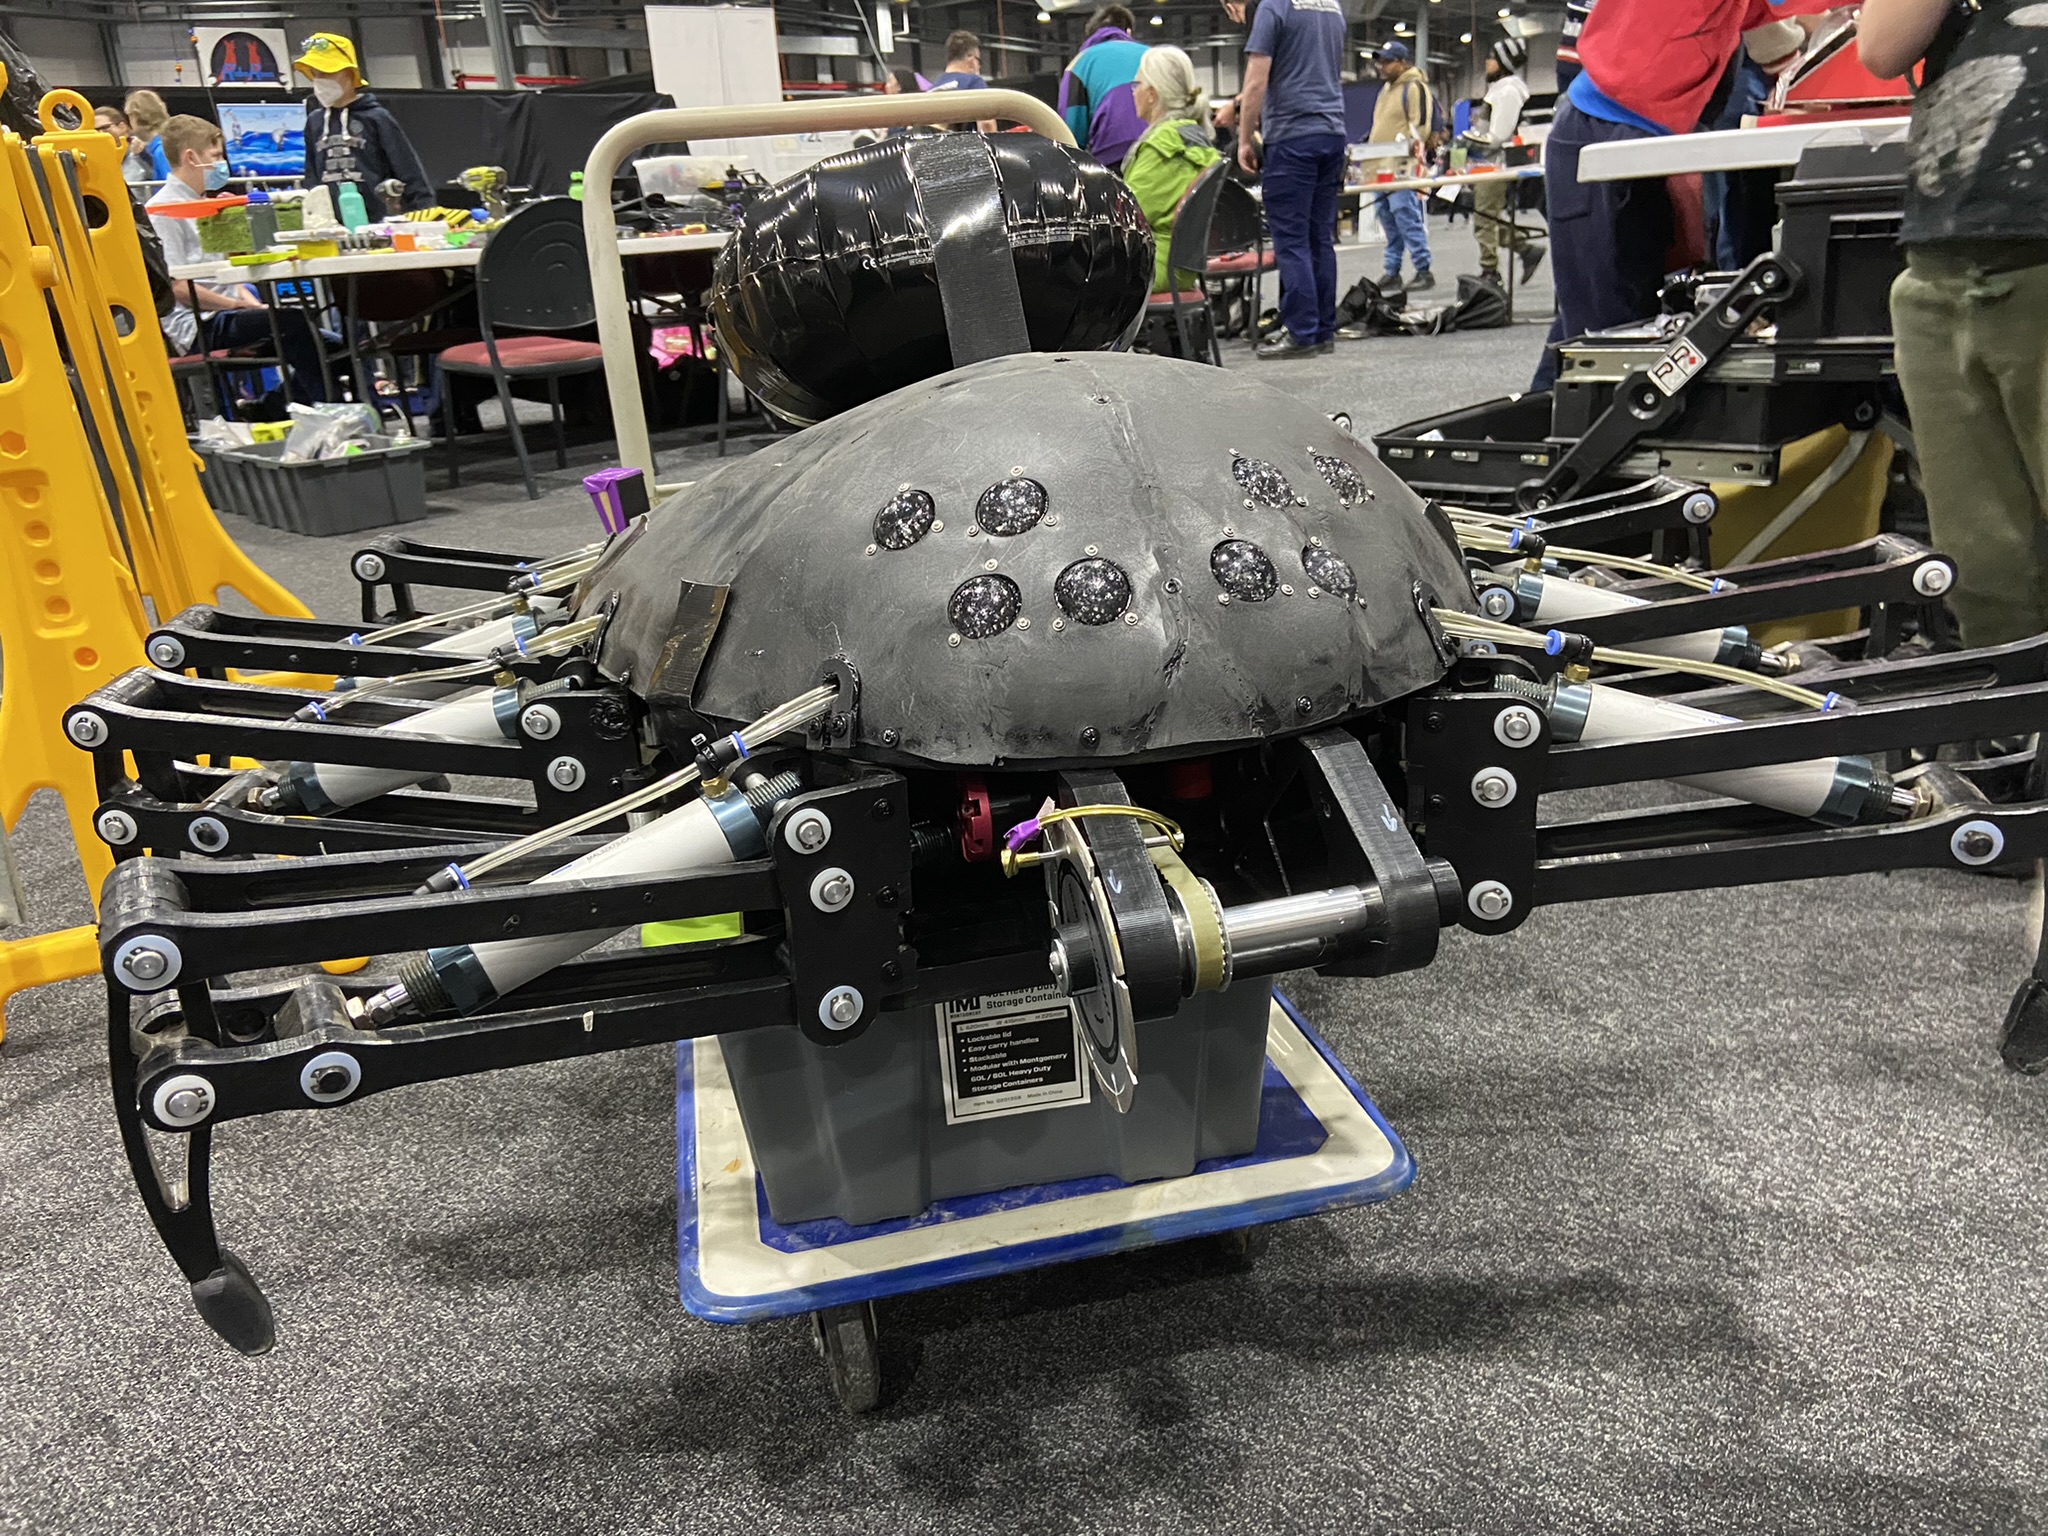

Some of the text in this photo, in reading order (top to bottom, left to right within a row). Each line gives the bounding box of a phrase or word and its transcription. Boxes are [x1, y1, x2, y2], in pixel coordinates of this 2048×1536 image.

[986, 997, 1024, 1009] Storage
[967, 1032, 1001, 1043] Lockable
[968, 1036, 1039, 1053] Easy carry handles
[969, 1052, 1007, 1063] Stackable
[970, 1052, 1068, 1072] Modular with Montgomery
[1008, 1068, 1032, 1077] Heavy
[1033, 1065, 1052, 1073] Duty
[971, 1077, 1044, 1093] Storage Containers
